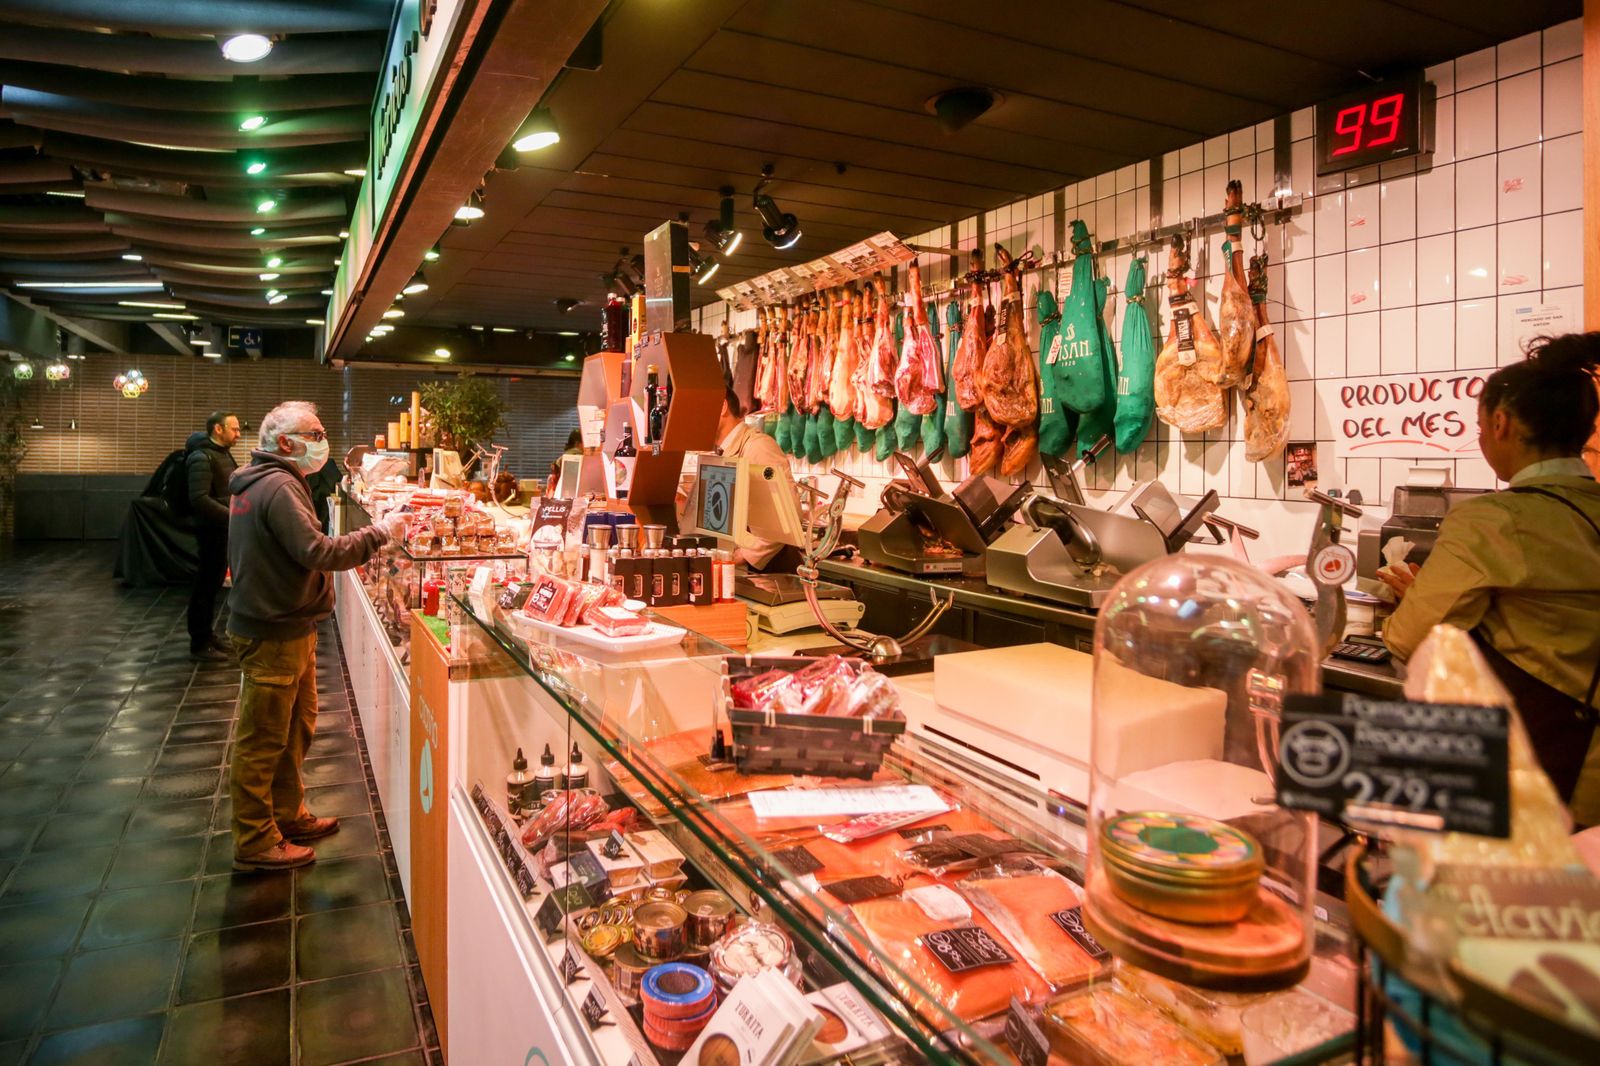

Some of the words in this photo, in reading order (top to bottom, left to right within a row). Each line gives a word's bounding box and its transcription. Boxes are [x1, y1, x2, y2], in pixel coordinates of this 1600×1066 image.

[1332, 93, 1404, 156] 99
[1341, 376, 1487, 408] PRODUCTO
[1343, 417, 1391, 438] DEL
[1401, 411, 1466, 438] MES
[735, 1000, 764, 1039] YURRITA
